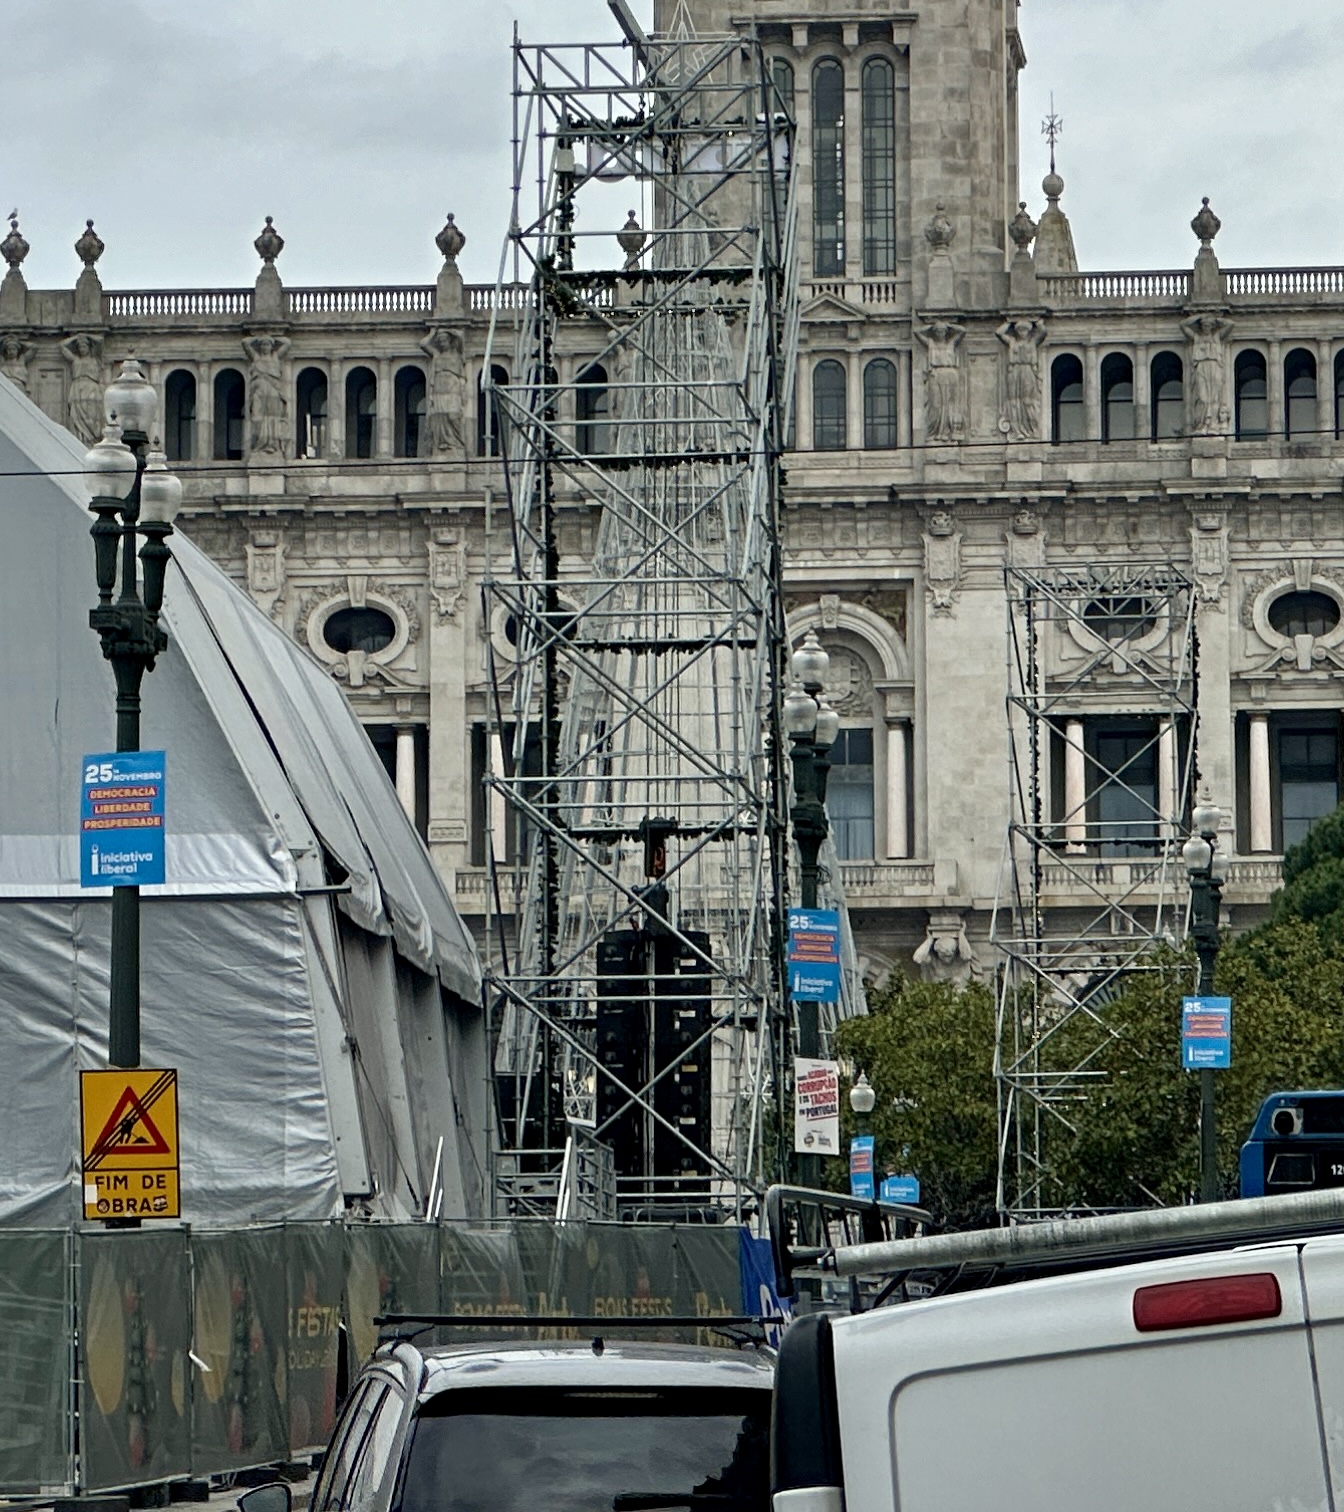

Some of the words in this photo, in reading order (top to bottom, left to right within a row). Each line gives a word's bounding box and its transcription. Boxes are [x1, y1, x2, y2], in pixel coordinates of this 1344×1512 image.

[85, 763, 113, 784] 25
[113, 772, 162, 781] NOVEMBRO
[89, 787, 156, 799] DEMOCRACIA
[94, 802, 151, 814] LIBERDADE
[84, 817, 161, 829] PROSPERIDADE
[100, 851, 153, 863] iniciativa
[100, 863, 138, 874] liberal
[789, 914, 809, 930] 25
[94, 1175, 128, 1191] FIM
[142, 1174, 167, 1190] DE
